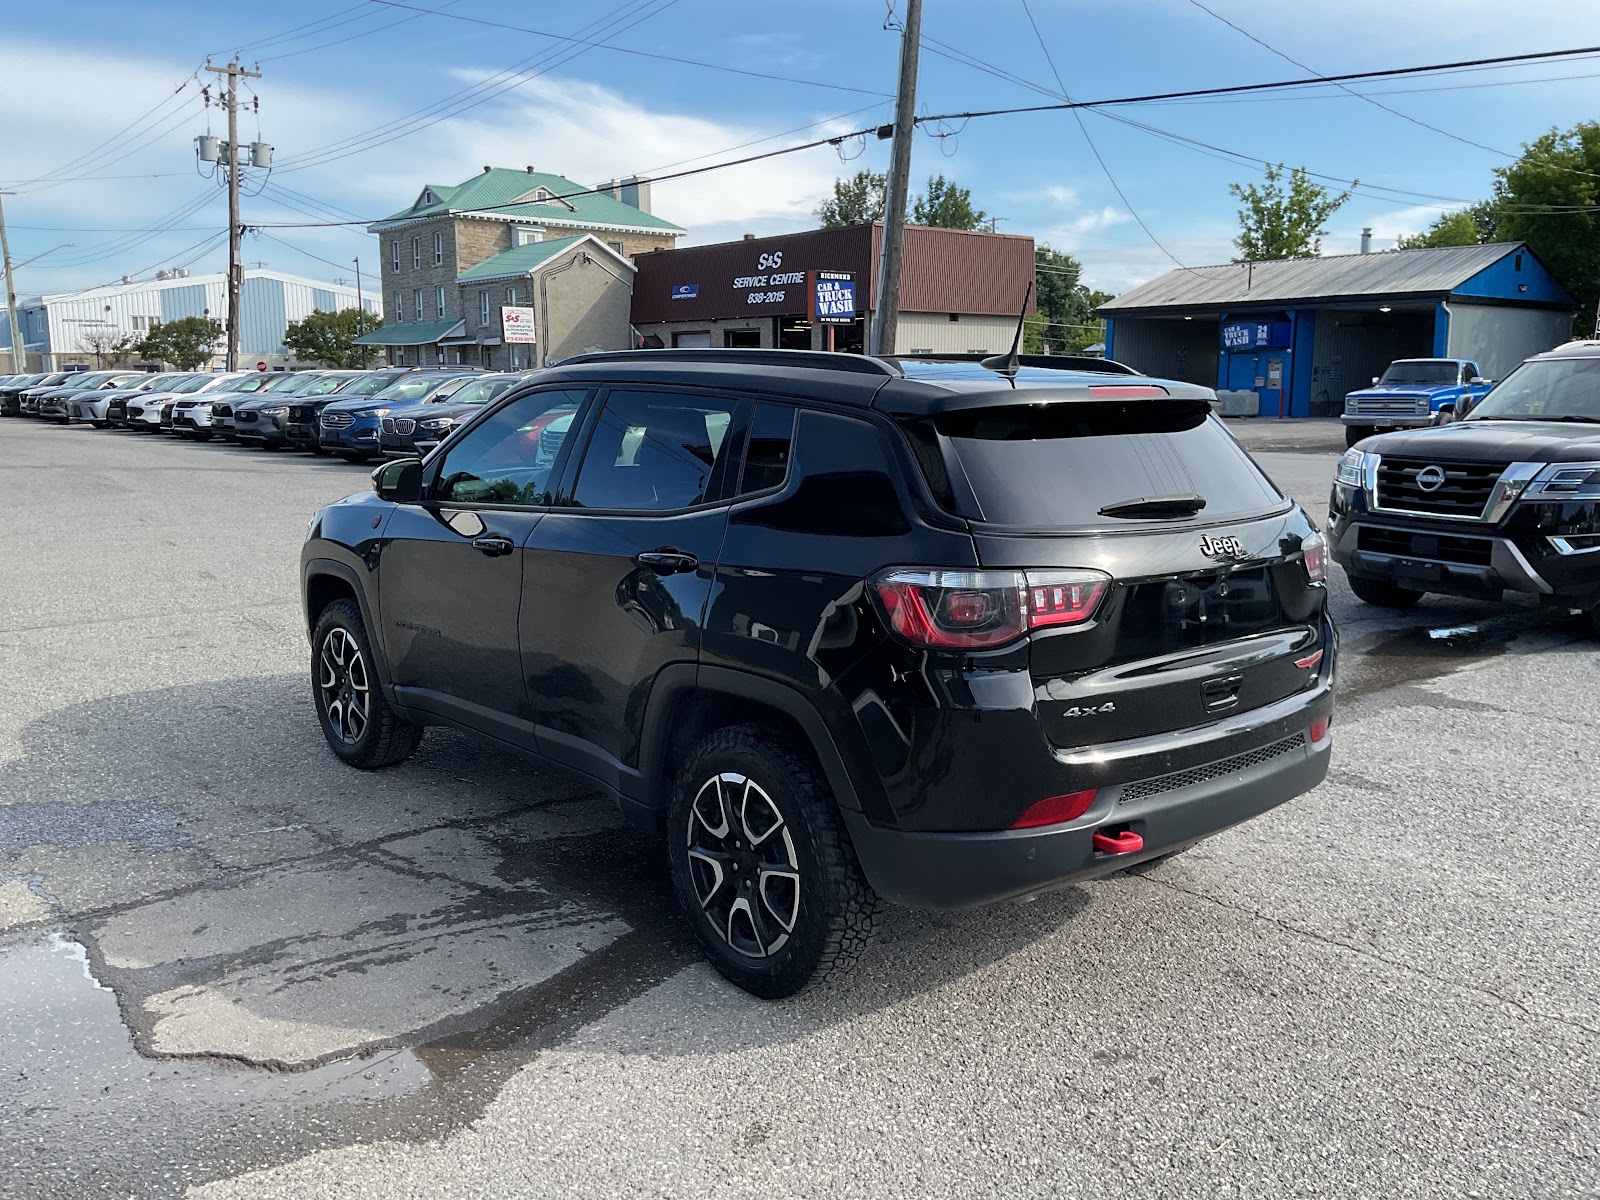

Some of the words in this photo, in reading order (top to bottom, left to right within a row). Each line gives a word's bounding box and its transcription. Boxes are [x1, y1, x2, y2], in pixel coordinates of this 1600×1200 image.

[758, 252, 782, 270] S&S
[732, 276, 768, 289] SERVICE
[770, 272, 806, 286] CENTRE
[817, 282, 833, 292] CAR
[834, 282, 840, 290] &
[747, 291, 786, 304] 838-2015
[818, 289, 852, 302] TRUCK
[819, 300, 853, 314] WASH
[1224, 329, 1248, 339] TRUCK
[1225, 336, 1249, 347] WASH
[1200, 534, 1242, 558] Jeep
[1063, 702, 1116, 717] 4x4
